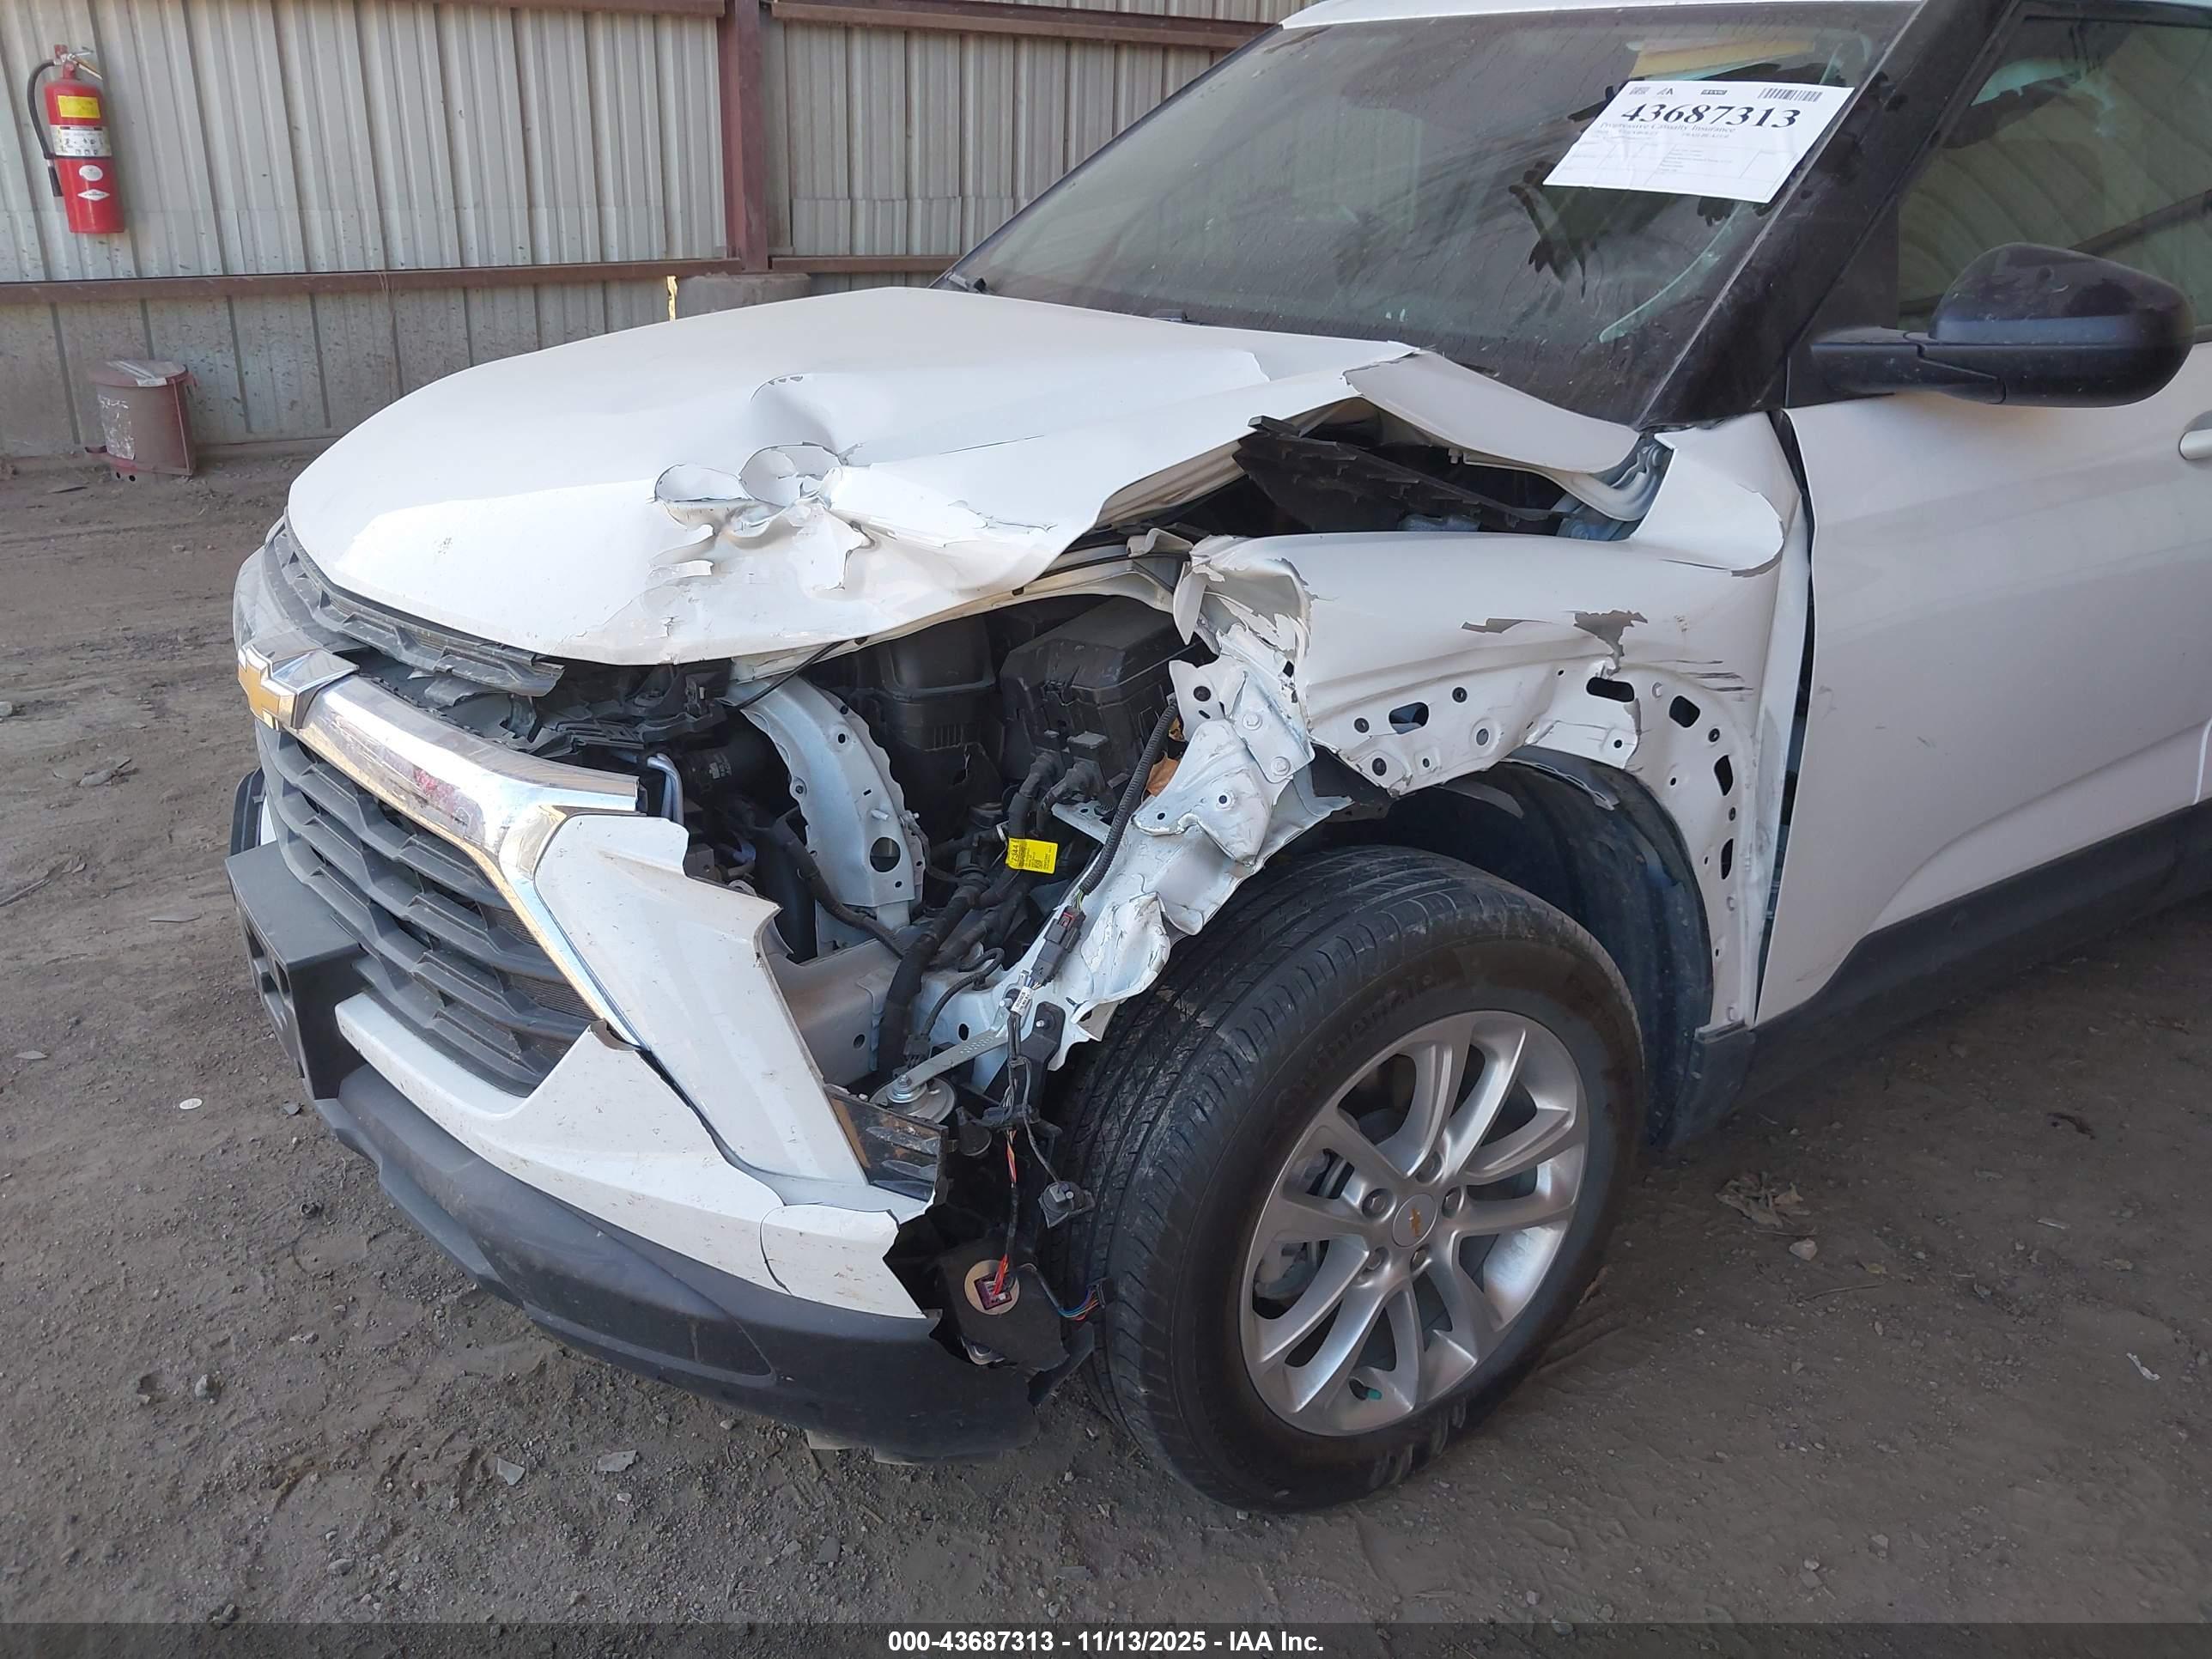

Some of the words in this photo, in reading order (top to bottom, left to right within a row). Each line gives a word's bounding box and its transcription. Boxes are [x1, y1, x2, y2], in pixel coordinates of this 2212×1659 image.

[1620, 102, 1802, 129] 43687313
[1600, 122, 1650, 131] Progressive
[1650, 123, 1688, 132] Casualty
[1691, 125, 1736, 134] Insurance
